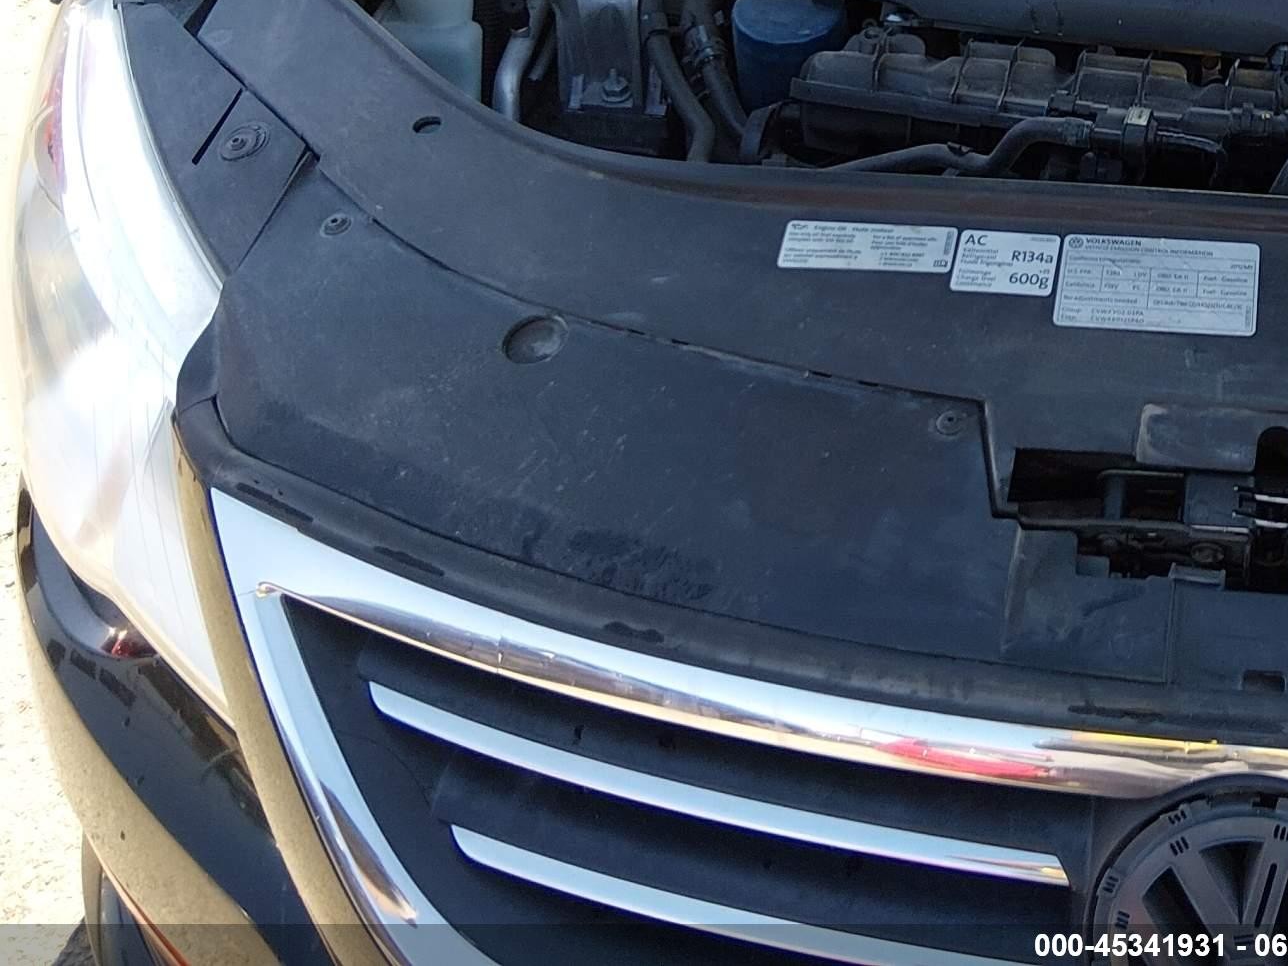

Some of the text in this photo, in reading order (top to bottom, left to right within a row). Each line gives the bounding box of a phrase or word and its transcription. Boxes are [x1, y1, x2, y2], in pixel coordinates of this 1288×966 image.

[965, 234, 988, 246] AC
[1086, 237, 1142, 246] VOLKSWAGEN
[1012, 250, 1054, 264] R134a
[1009, 272, 1049, 290] 600g
